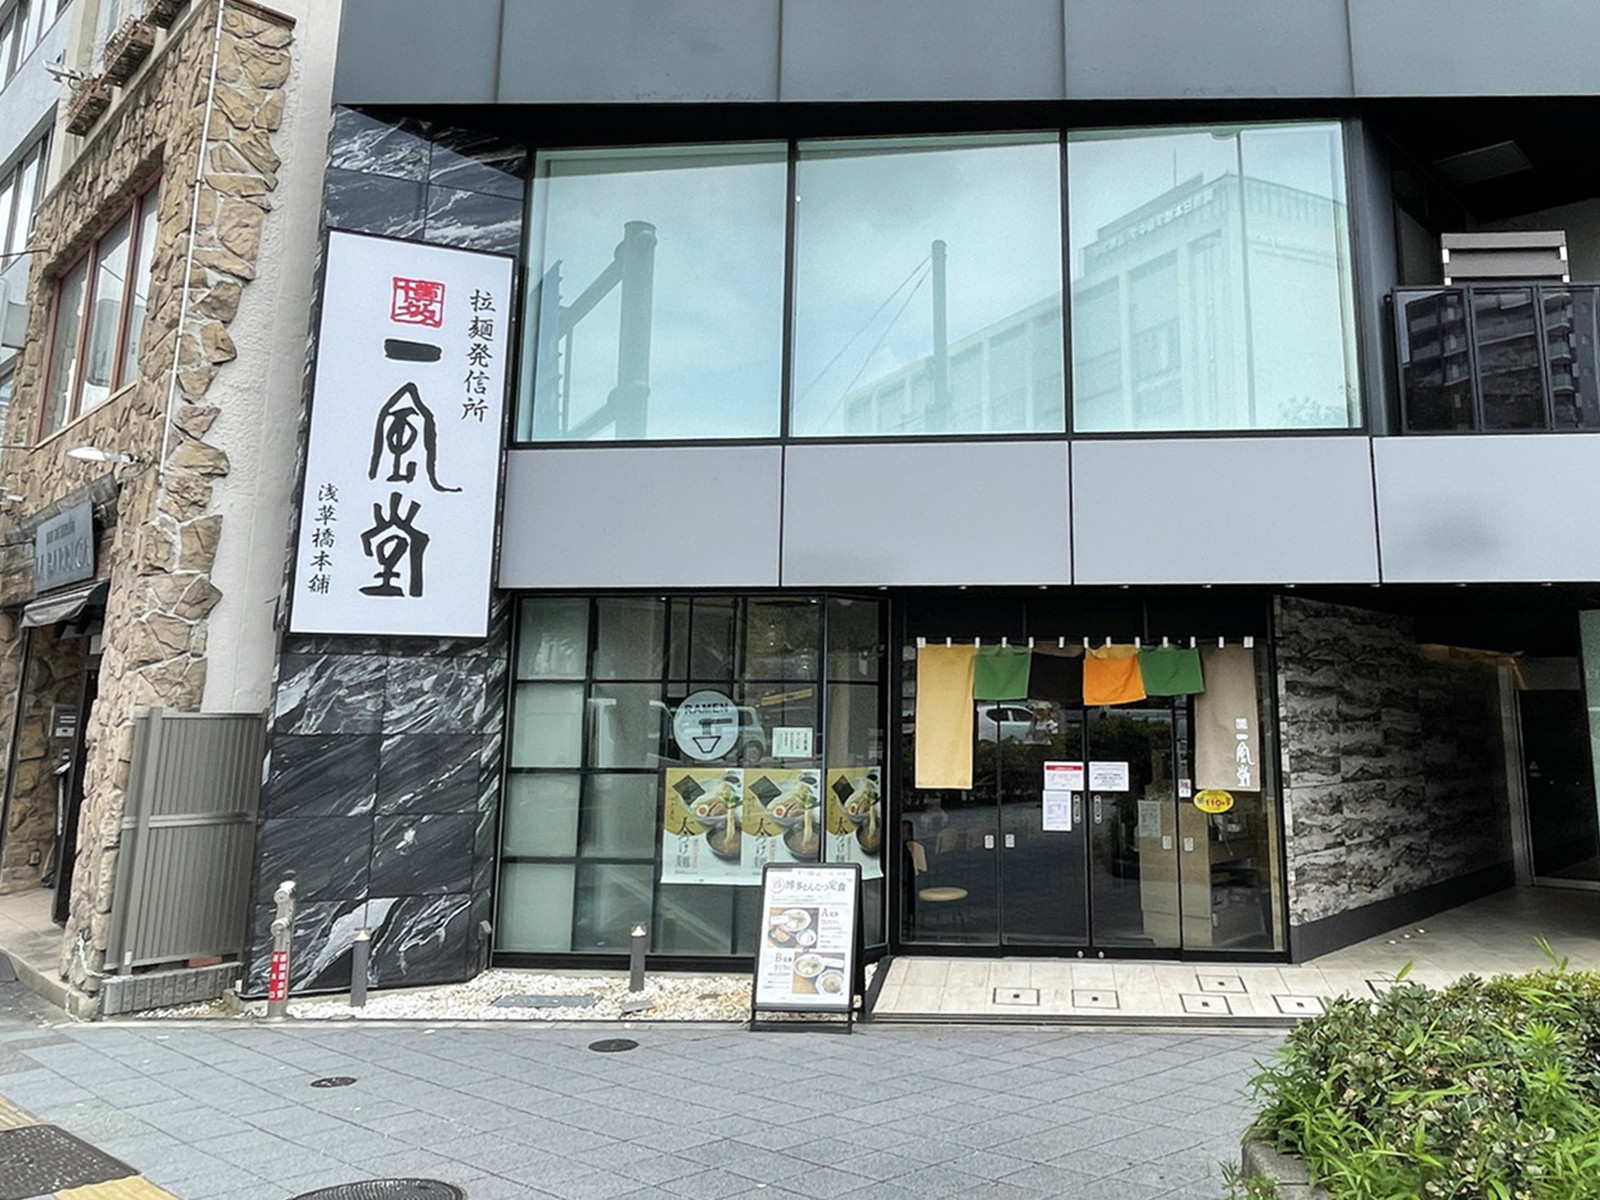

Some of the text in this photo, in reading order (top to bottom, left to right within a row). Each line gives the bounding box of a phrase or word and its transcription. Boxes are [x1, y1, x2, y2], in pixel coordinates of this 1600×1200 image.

[461, 289, 496, 423] 拉麺発信所
[359, 338, 463, 598] 一風堂
[684, 702, 729, 715] RAMEN
